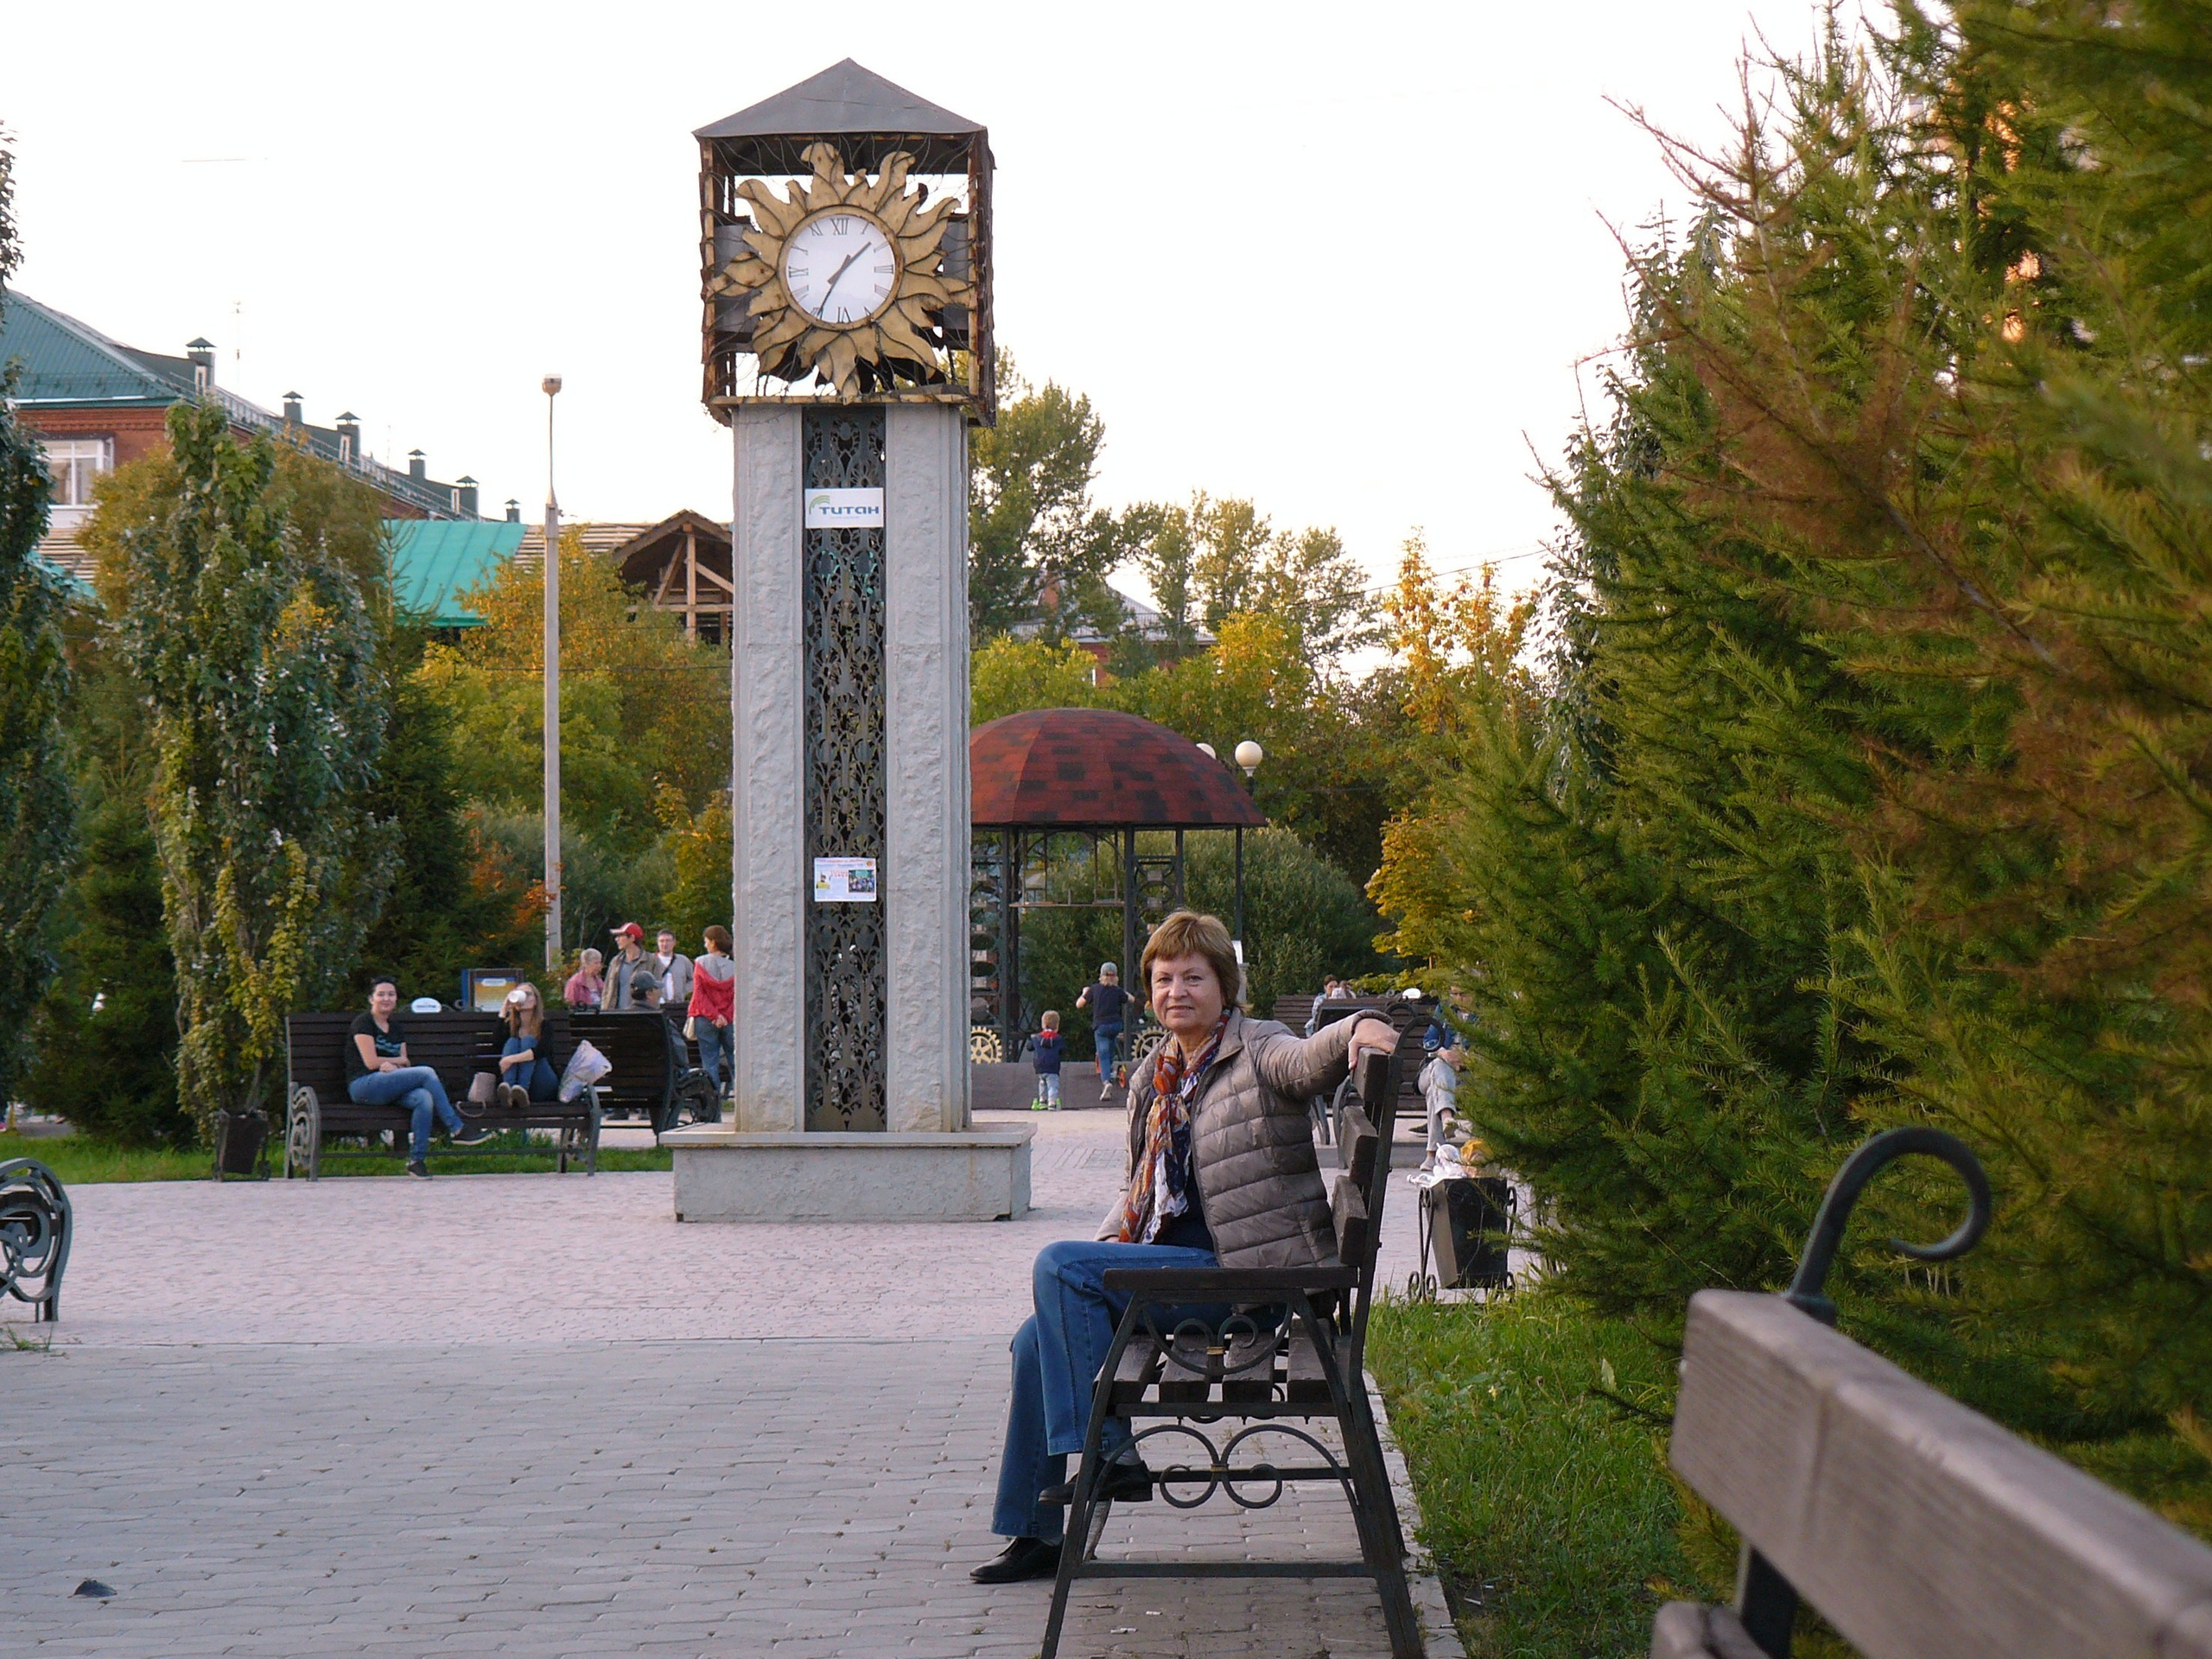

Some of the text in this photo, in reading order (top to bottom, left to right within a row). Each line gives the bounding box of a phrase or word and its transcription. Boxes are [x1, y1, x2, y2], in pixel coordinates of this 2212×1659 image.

[809, 220, 823, 236] XI
[830, 217, 849, 236] XII
[788, 265, 809, 278] IX
[874, 264, 894, 274] III
[836, 306, 852, 324] VI
